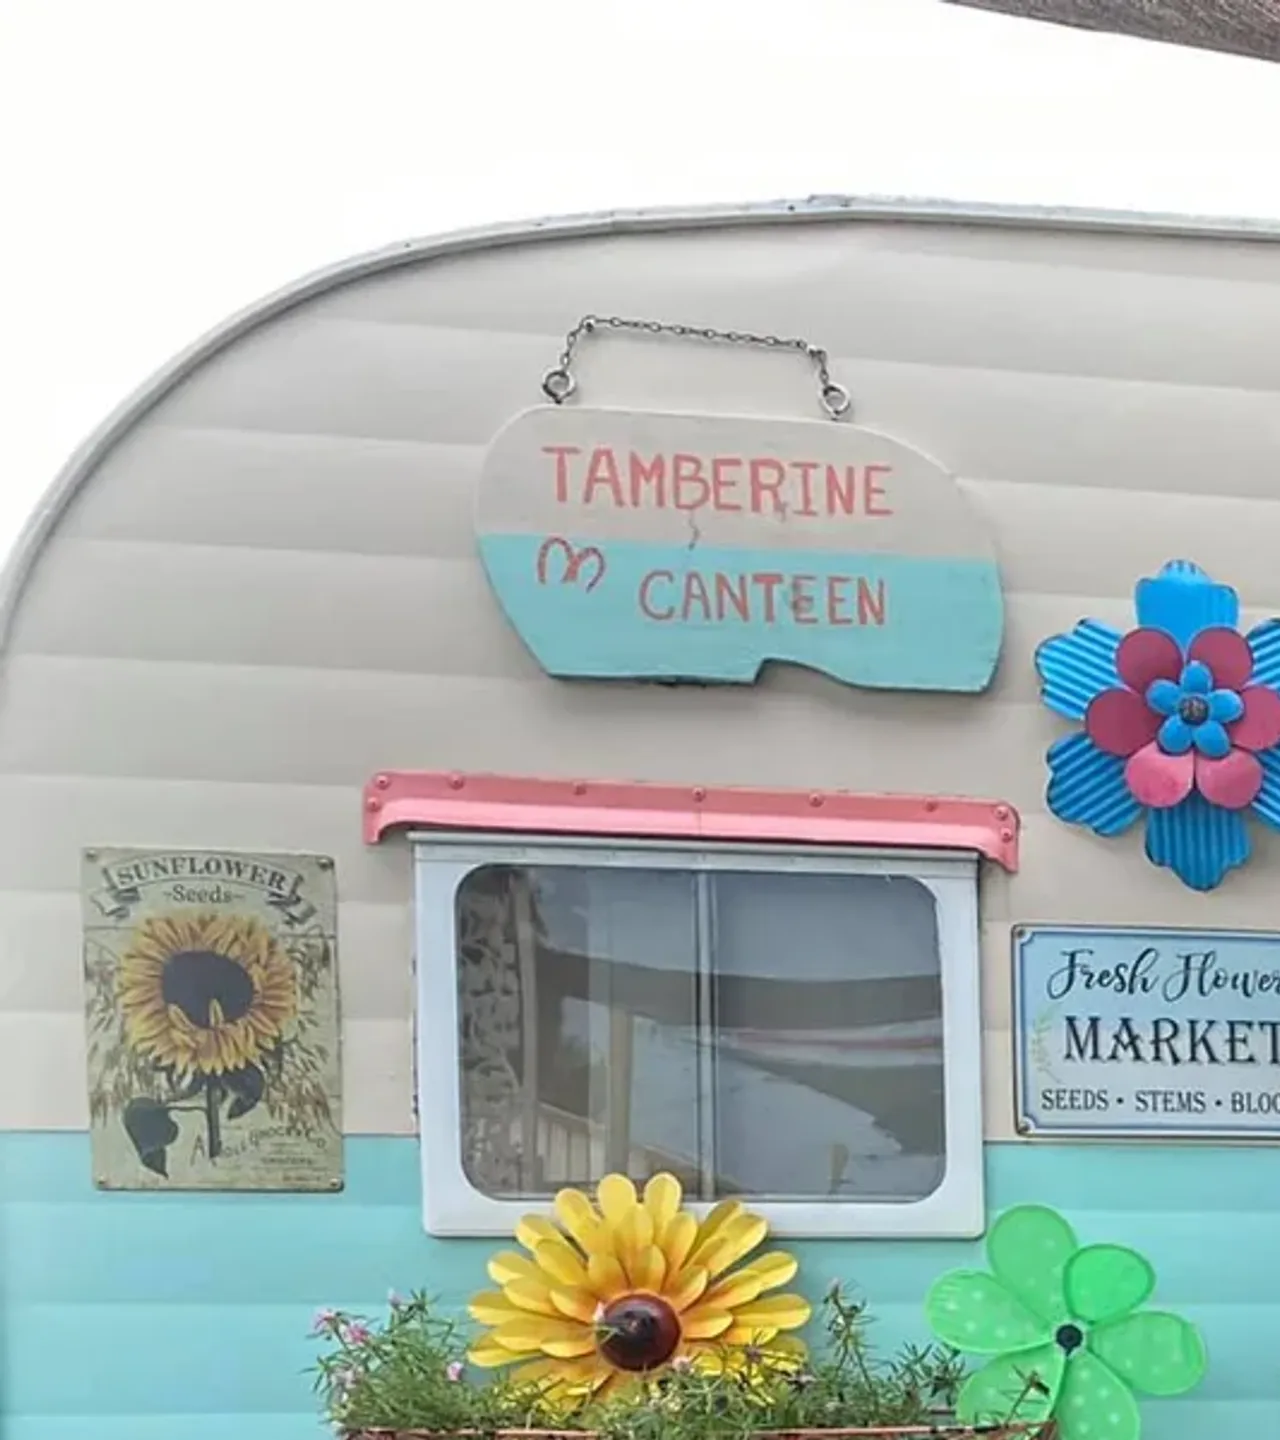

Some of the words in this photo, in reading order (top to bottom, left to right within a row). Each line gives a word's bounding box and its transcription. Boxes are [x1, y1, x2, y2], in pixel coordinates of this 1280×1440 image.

[541, 446, 894, 517] TAMBERINE
[638, 569, 887, 626] CANTEEN
[115, 855, 288, 892] SUNFLOWER
[1046, 947, 1160, 1000] Fresh
[1040, 1088, 1109, 1112] SEEDS
[1135, 1090, 1207, 1115] STEMS
